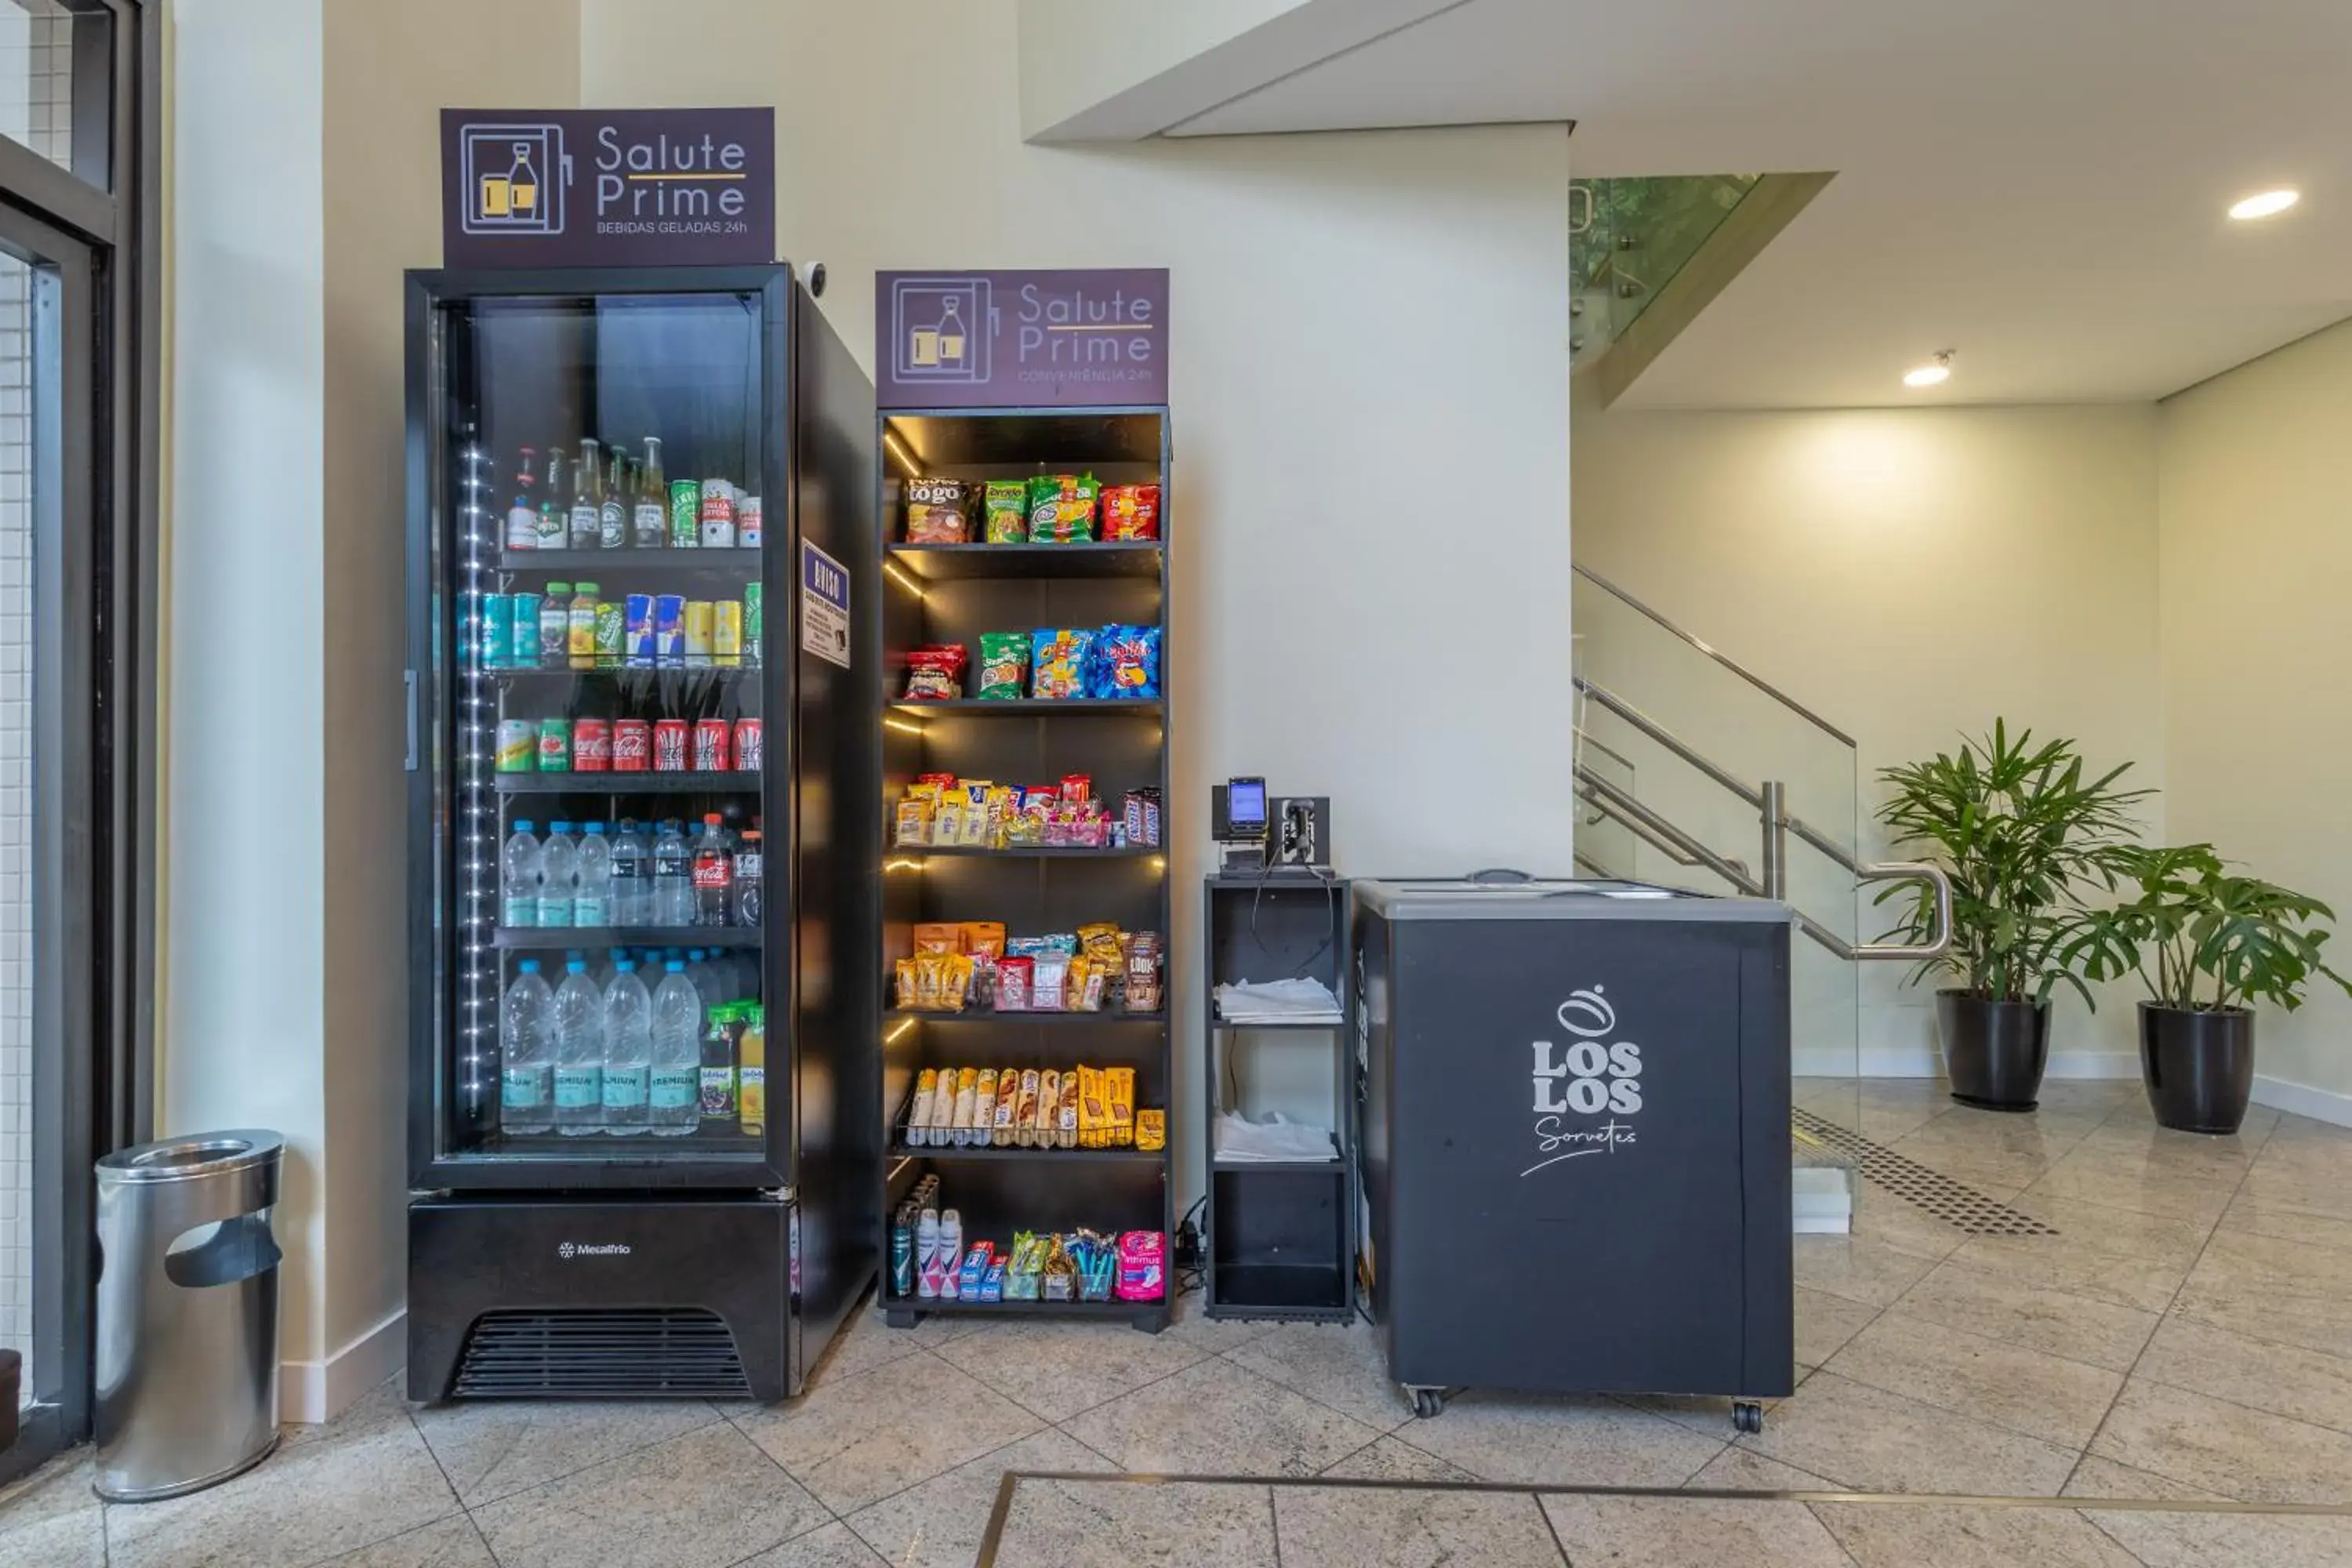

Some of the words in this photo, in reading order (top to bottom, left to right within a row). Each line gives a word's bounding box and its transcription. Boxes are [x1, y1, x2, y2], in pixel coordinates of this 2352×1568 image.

[596, 125, 746, 171] Salute
[597, 175, 746, 216] Prime
[597, 222, 655, 234] BEBIDAS
[659, 222, 720, 234] GELADAS
[725, 222, 747, 234] 24h
[1018, 284, 1152, 323] Salute
[1020, 326, 1152, 363] Prime
[1533, 1041, 1642, 1078] LOS
[1533, 1077, 1642, 1114] LOS
[1534, 1116, 1637, 1154] Sorvetes
